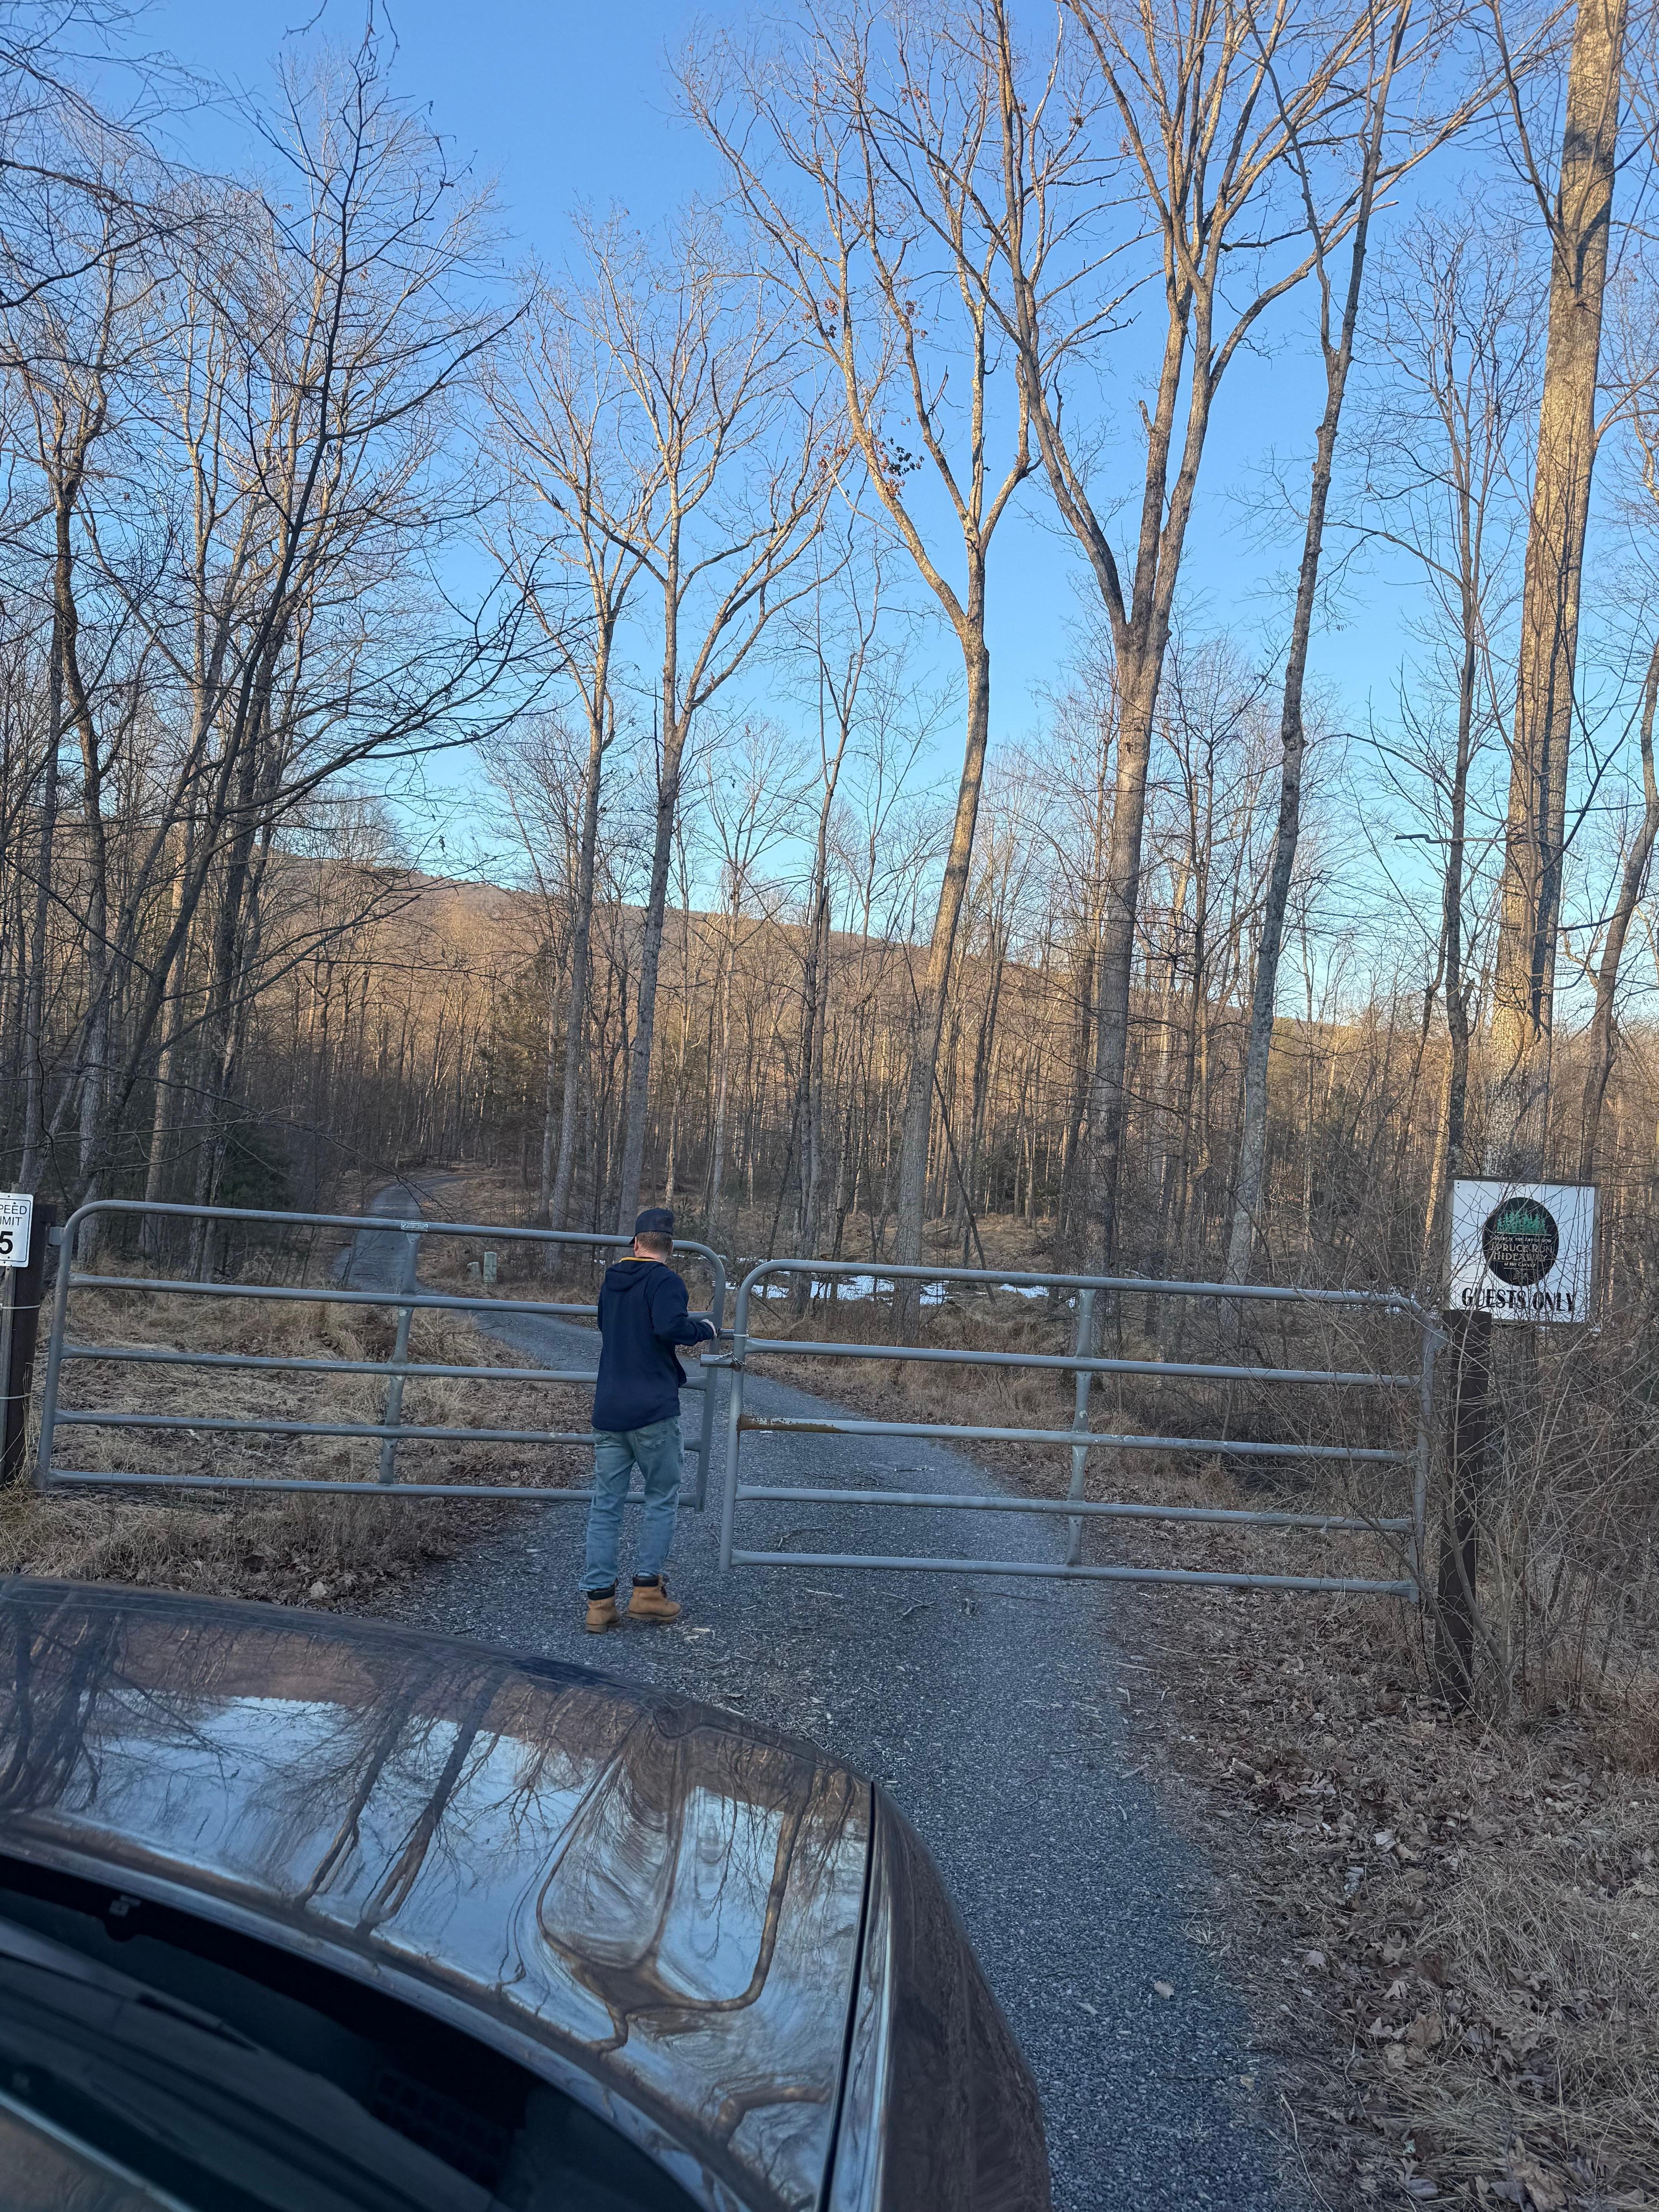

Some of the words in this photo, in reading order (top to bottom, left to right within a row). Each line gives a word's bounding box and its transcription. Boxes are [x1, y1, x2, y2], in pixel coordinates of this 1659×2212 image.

[0, 1216, 22, 1226] IMIT
[1462, 1288, 1526, 1309] GUESTS
[1533, 1290, 1575, 1311] ONLY
